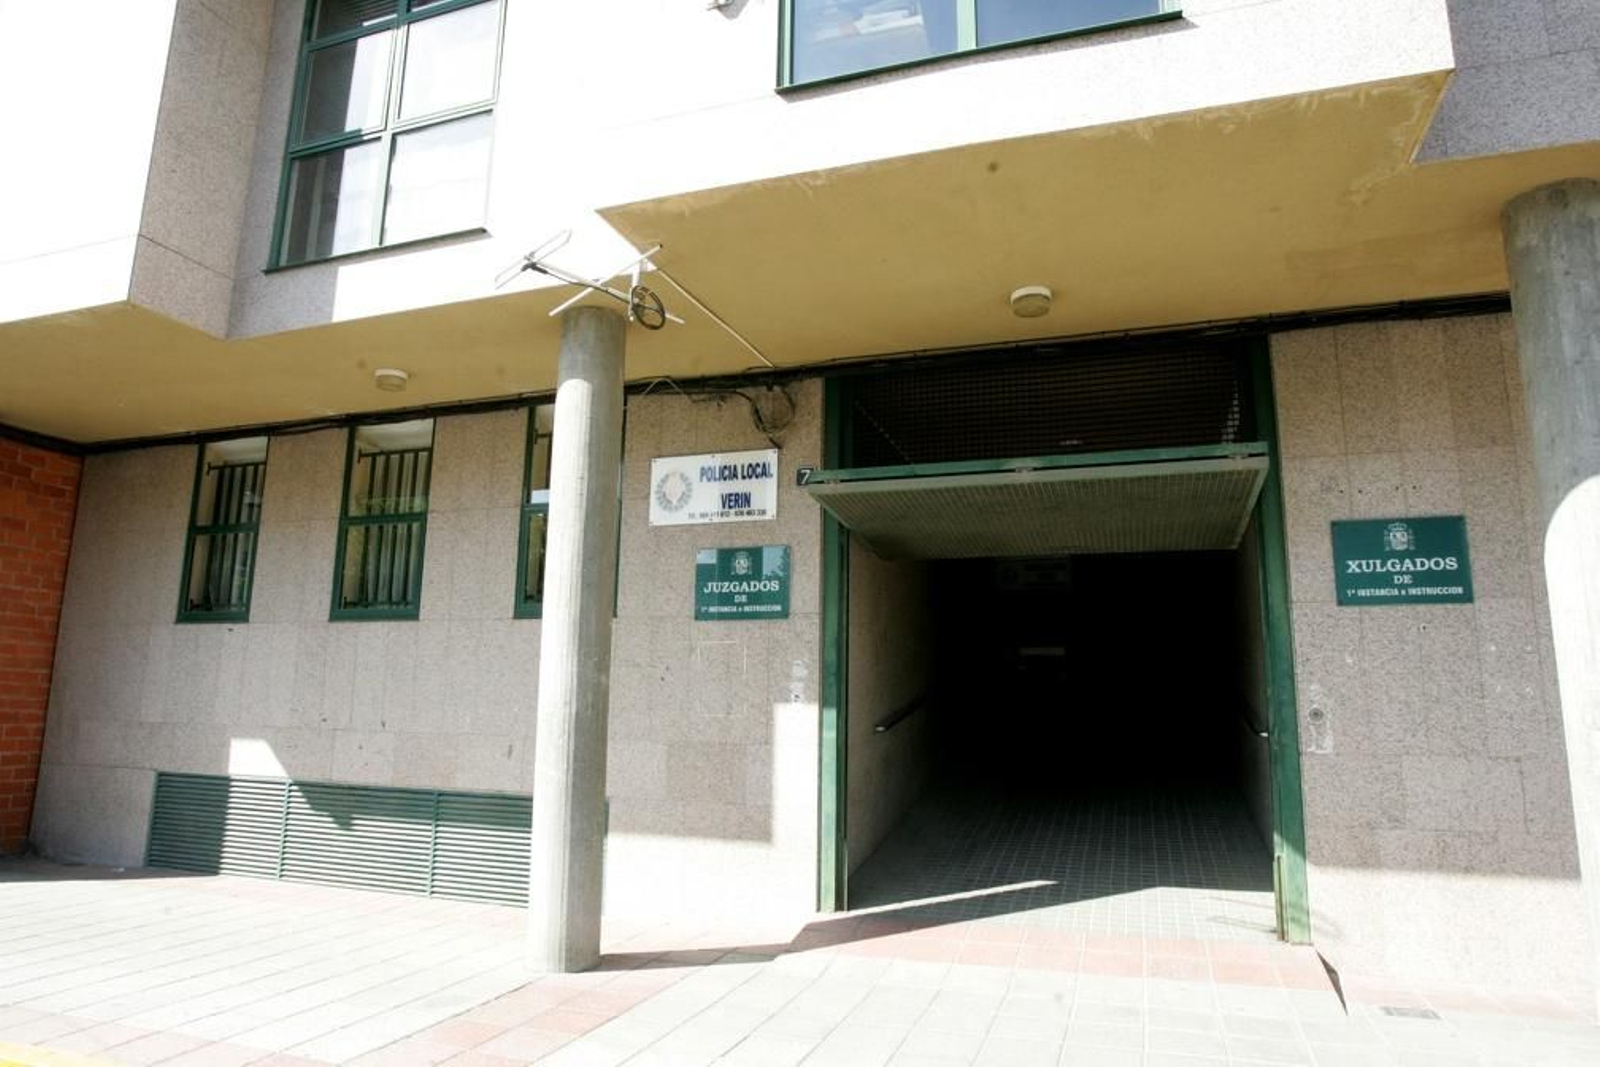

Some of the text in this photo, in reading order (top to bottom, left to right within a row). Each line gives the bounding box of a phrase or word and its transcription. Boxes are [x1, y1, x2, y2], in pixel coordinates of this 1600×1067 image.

[700, 462, 773, 482] POLICIA LOCAL
[800, 469, 811, 485] 7
[721, 491, 752, 510] VERIN
[1346, 557, 1458, 573] XULGADOS
[1393, 574, 1413, 584] DE
[703, 581, 779, 593] JUZGADOS
[1357, 587, 1399, 598] INSTANCIA
[734, 594, 748, 603] DE
